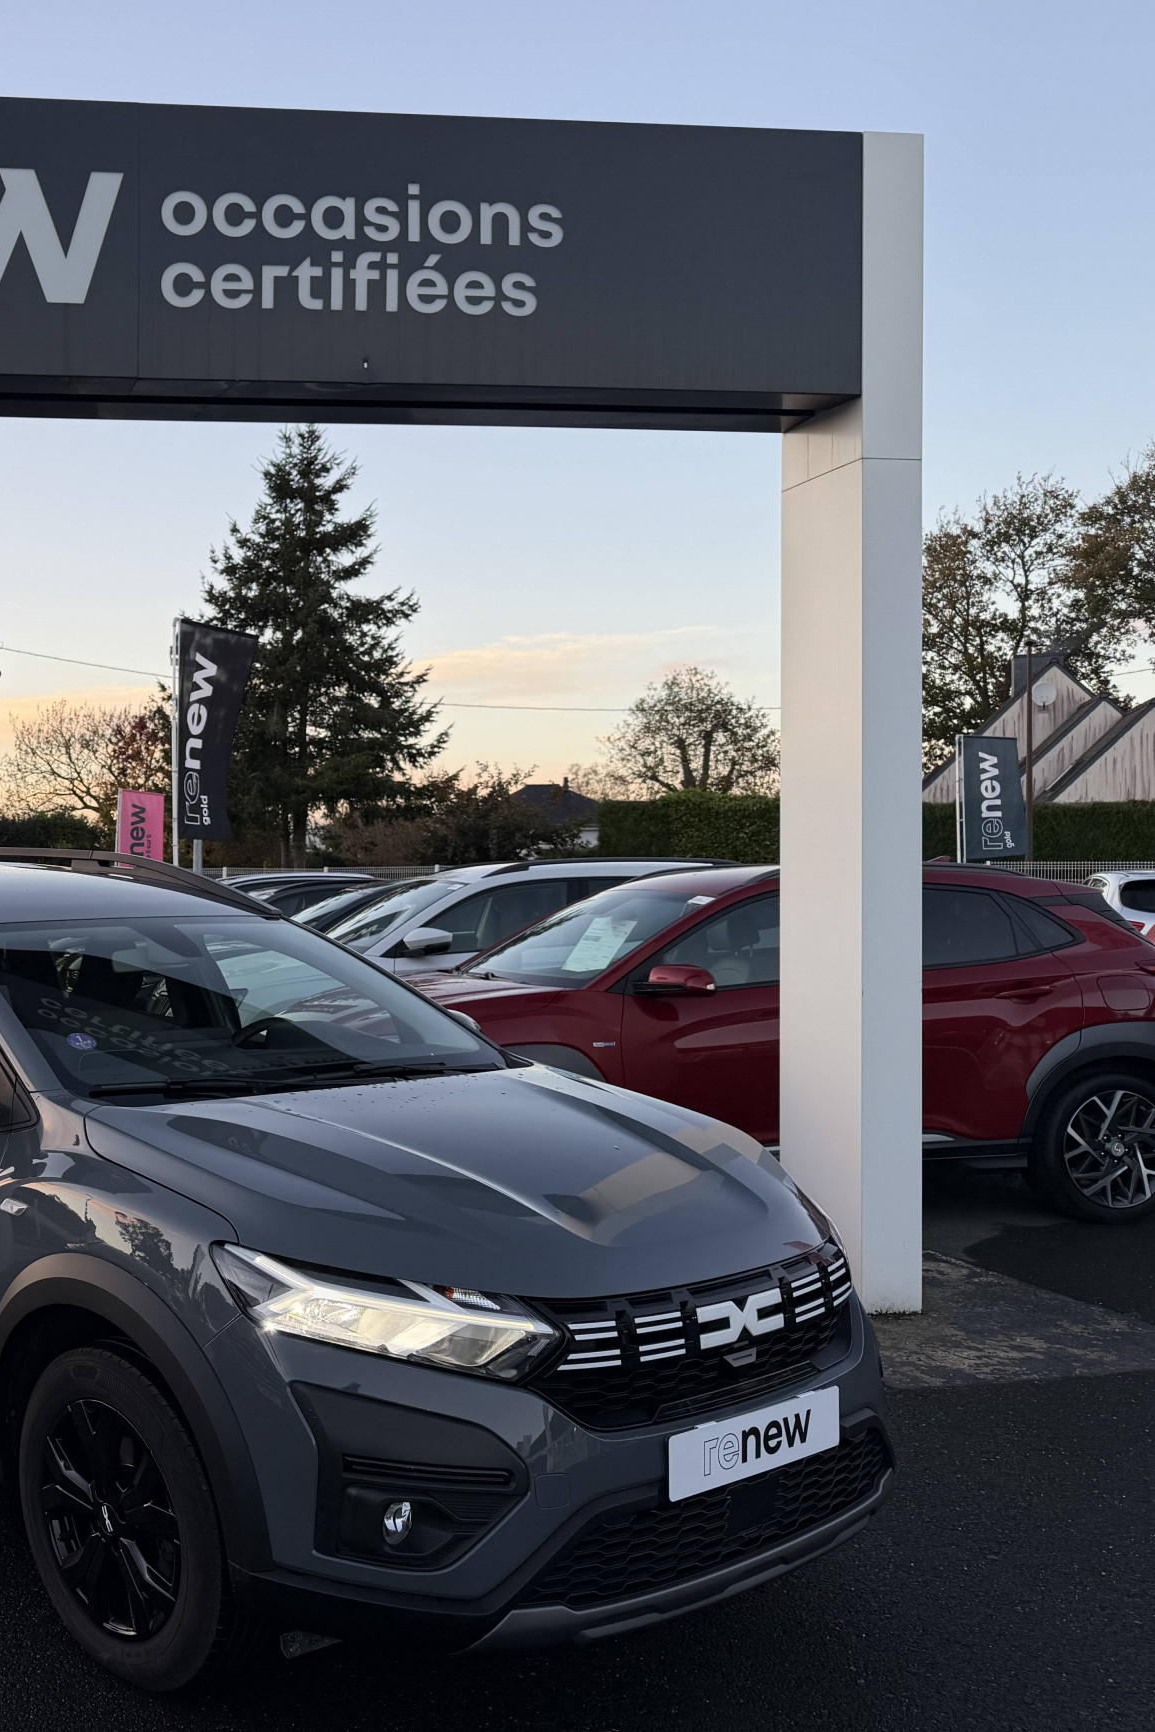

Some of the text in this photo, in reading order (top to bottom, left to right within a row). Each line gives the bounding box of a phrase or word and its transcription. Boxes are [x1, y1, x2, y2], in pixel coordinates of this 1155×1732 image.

[160, 183, 564, 248] occasions
[160, 250, 538, 317] certifiées
[184, 652, 218, 826] renew
[200, 795, 211, 826] gold
[979, 751, 1004, 850] renew
[1004, 831, 1015, 849] gold
[703, 1409, 812, 1477] renew
